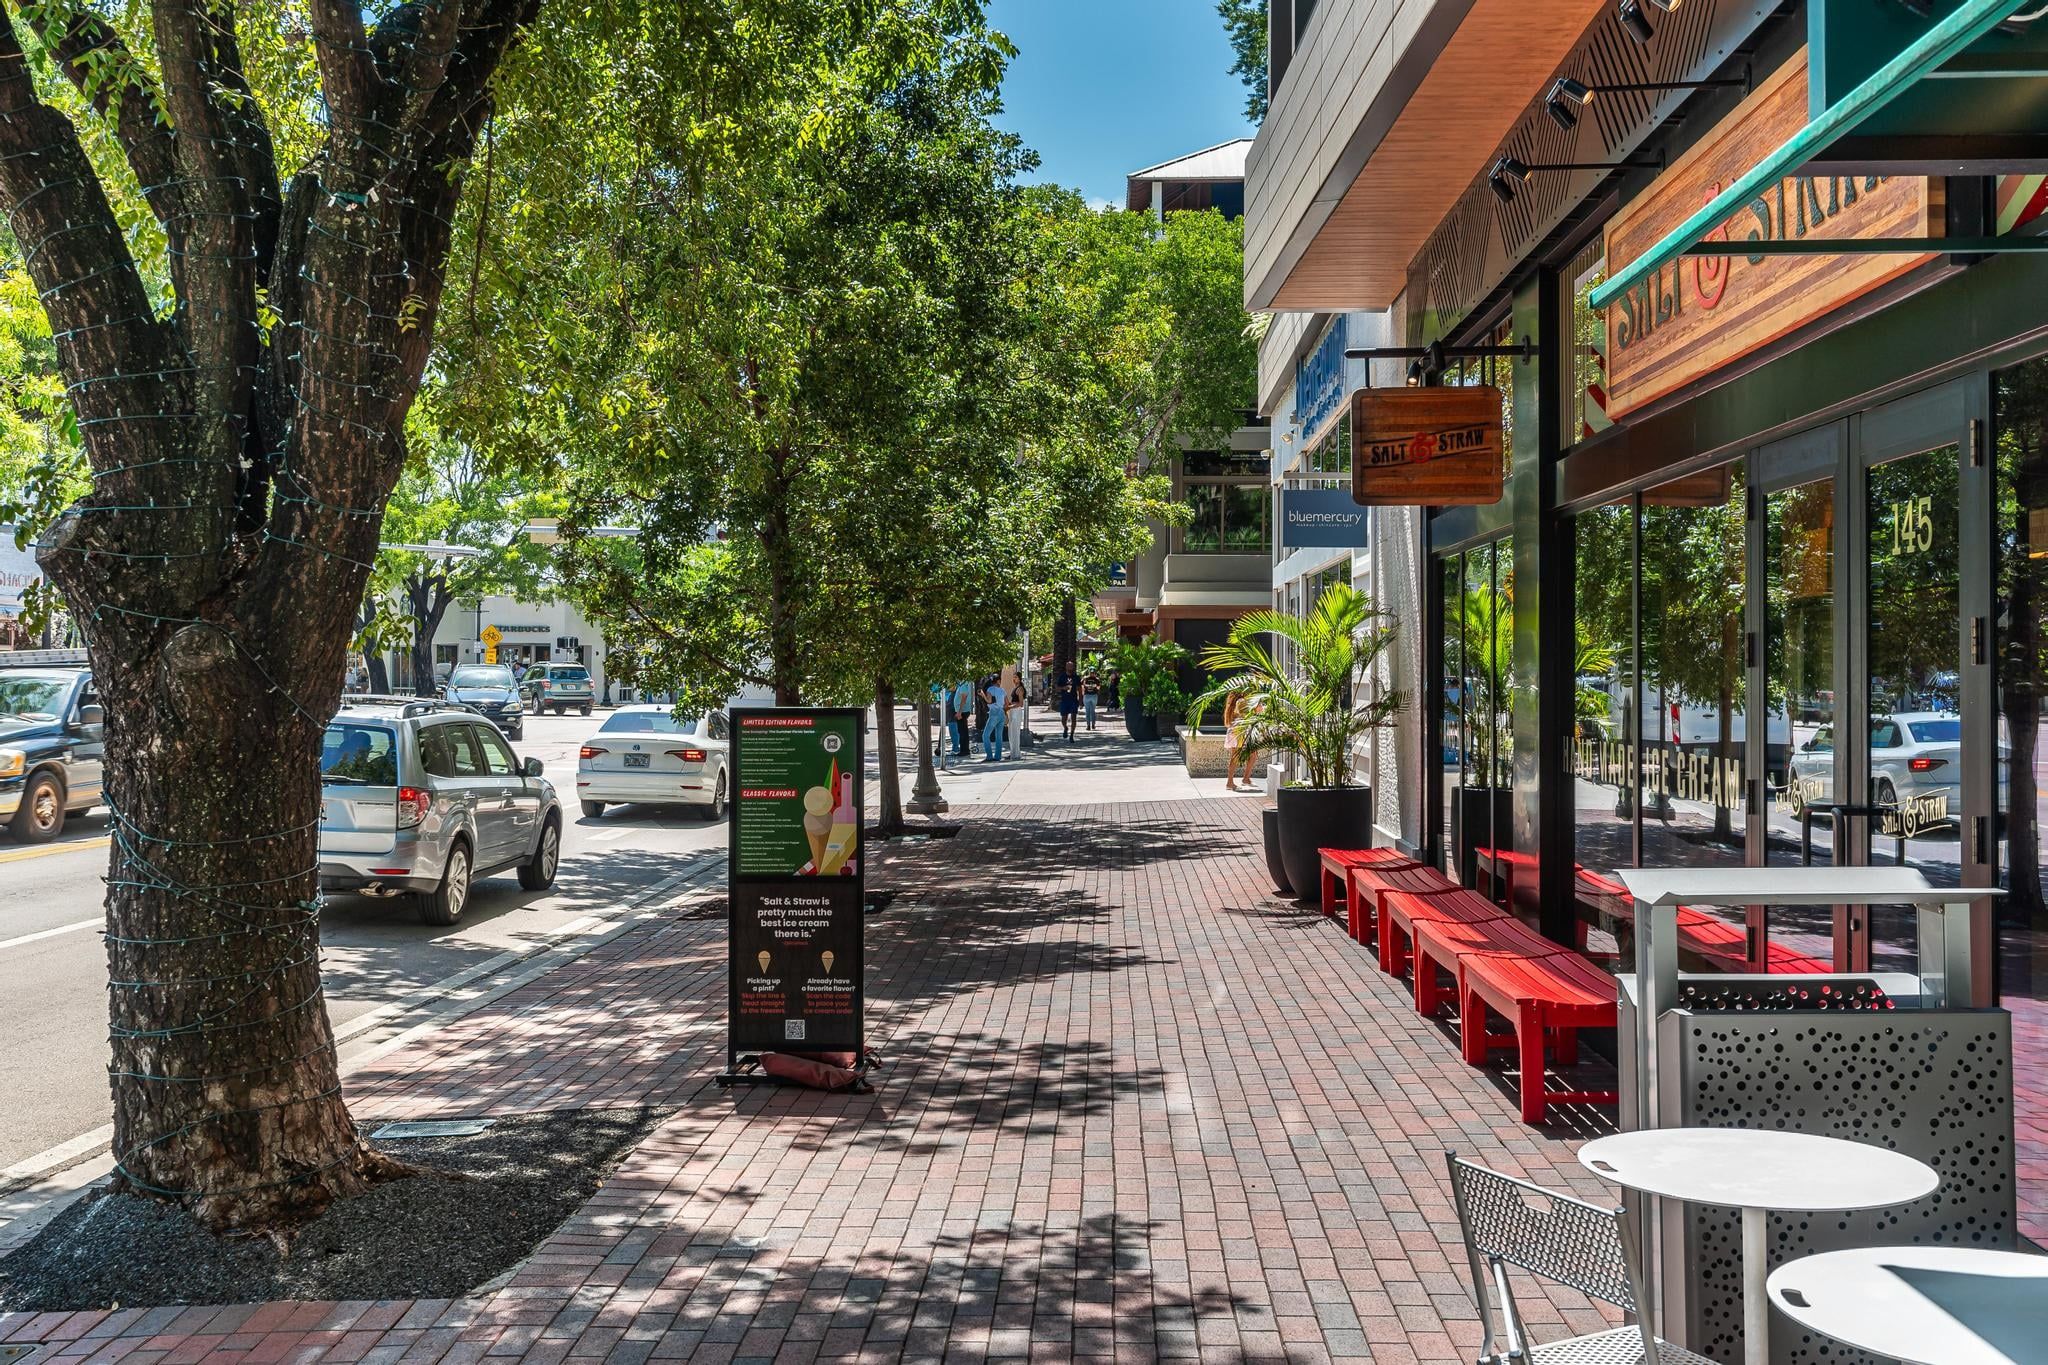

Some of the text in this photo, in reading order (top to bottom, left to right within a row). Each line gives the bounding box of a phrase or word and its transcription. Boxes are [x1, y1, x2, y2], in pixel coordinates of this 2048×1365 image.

[1747, 176, 1889, 265] STR
[1371, 429, 1484, 464] SALT & STRAW
[1288, 510, 1362, 525] bluemercury
[1892, 496, 1933, 555] 145
[494, 624, 551, 633] TARBUCKS
[1563, 736, 1740, 810] HAND MADE ICE CREAM
[1775, 779, 1825, 816] SALT & STRAW
[1882, 796, 1947, 838] SALT & STRAW
[784, 897, 791, 905] &
[793, 897, 820, 905] Straw
[822, 896, 830, 905] is
[757, 908, 832, 918] pretty much the
[760, 919, 781, 927] best
[783, 918, 797, 927] ice
[774, 929, 799, 938] there
[746, 977, 771, 985] Picking
